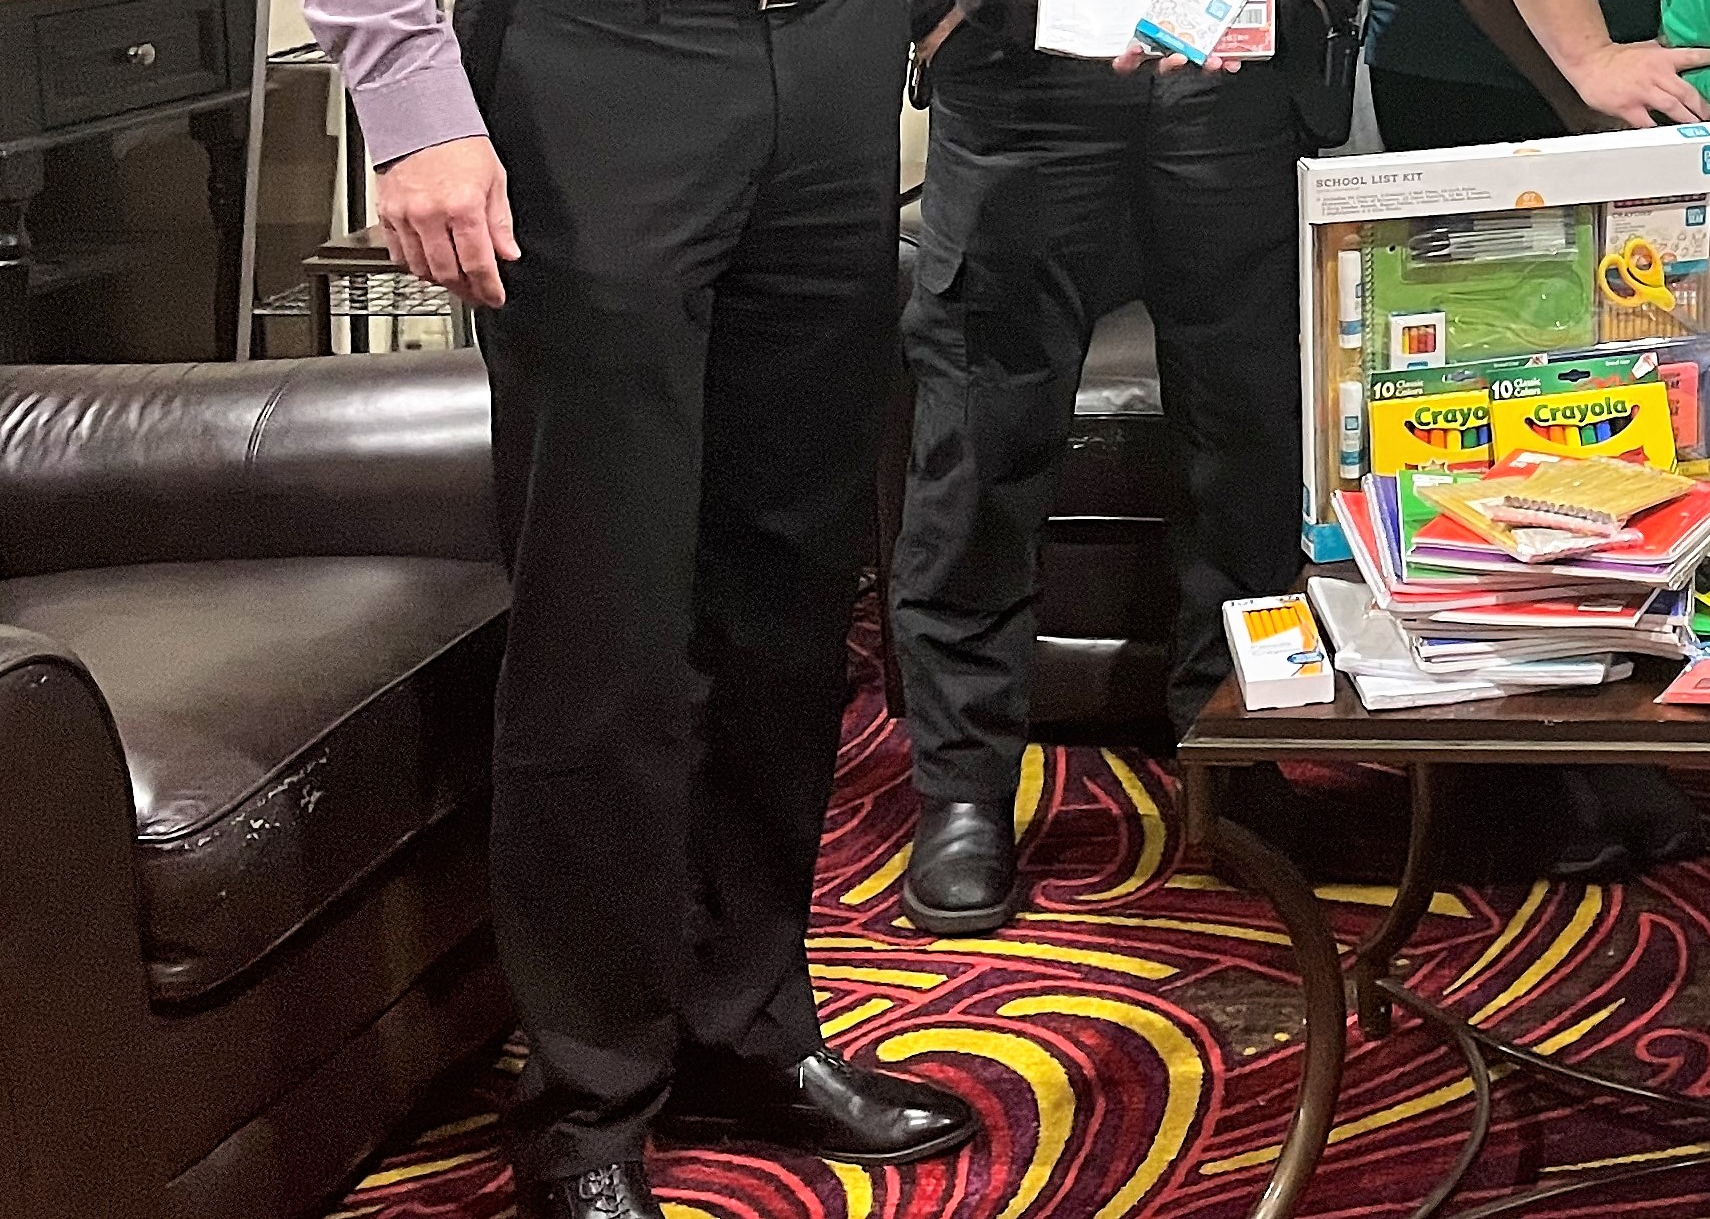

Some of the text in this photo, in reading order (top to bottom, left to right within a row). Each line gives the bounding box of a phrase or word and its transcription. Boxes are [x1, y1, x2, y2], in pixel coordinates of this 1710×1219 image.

[1316, 172, 1424, 188] SCHOOL LIST KIT
[1373, 381, 1395, 400] 10
[1491, 380, 1514, 400] 10
[1414, 406, 1489, 427] Crayo
[1534, 396, 1628, 423] Crayola
